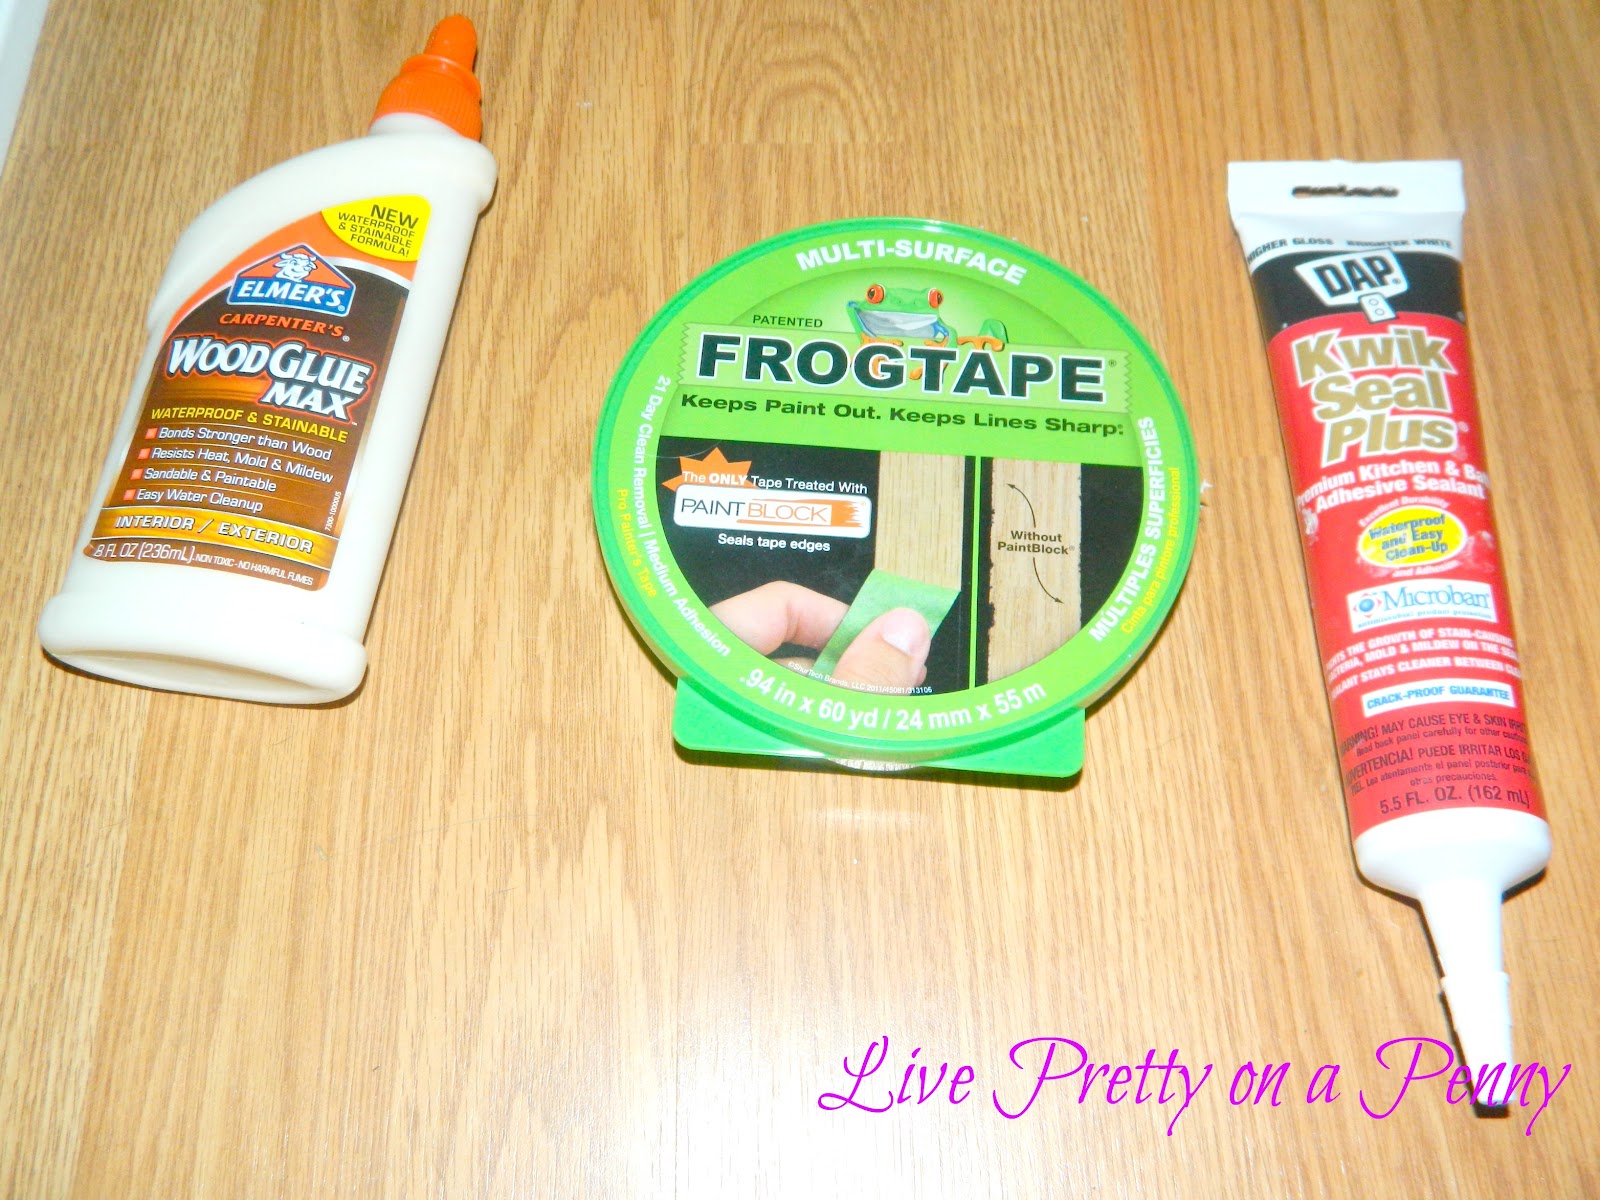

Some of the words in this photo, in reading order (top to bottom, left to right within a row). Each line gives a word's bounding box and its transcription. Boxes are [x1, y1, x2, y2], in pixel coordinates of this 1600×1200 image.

[338, 211, 415, 238] WATERPROOF
[371, 205, 418, 229] NEW
[339, 222, 346, 231] &
[349, 224, 412, 249] STAINABLE
[350, 233, 410, 257] FORMULA!
[796, 239, 1027, 286] MULTI-SURFACE
[1314, 255, 1394, 297] DAP
[237, 280, 345, 308] ELMER'S
[219, 312, 345, 338] CARPENTER'S
[752, 315, 823, 328] PATENTED
[697, 332, 1106, 403] FROGTAPE
[1292, 325, 1458, 387] Kwik
[658, 376, 670, 393] 21
[1311, 369, 1452, 421] Seal
[259, 379, 355, 420] MAX
[642, 394, 663, 420] Day
[682, 394, 757, 413] Keeps
[765, 398, 825, 417] Paint
[834, 403, 882, 420] Out.
[890, 408, 966, 427] Keeps
[974, 412, 1038, 430] Lines
[151, 407, 244, 421] WATERPROOF
[247, 412, 257, 423] &
[263, 414, 349, 443] STAINABLE
[158, 428, 196, 439] Bonds
[197, 429, 255, 445] Stronger
[257, 436, 288, 450] than
[292, 441, 332, 460] Wood
[634, 422, 653, 464] Clean
[1321, 411, 1458, 468] Plus
[151, 447, 195, 460] Resists
[198, 449, 231, 463] Heat,
[234, 453, 269, 469] Mold
[271, 460, 282, 471] &
[285, 462, 334, 483] Mildew
[1138, 416, 1165, 540] SUPERFICIES
[1359, 459, 1441, 481] Kitchen
[1445, 460, 1460, 476] &
[144, 468, 198, 480] Sandable
[201, 470, 212, 481] &
[215, 472, 277, 492] Paintable
[682, 472, 706, 483] The
[708, 473, 747, 486] ONLY
[751, 476, 782, 488] Tape
[785, 478, 834, 491] Treated
[838, 482, 867, 494] With
[136, 489, 165, 502] Easy
[167, 490, 207, 502] Water
[210, 491, 263, 513] Cleanup
[616, 488, 628, 510] Pro
[633, 468, 652, 531] Removal
[1316, 478, 1408, 514] Adhesive
[1412, 475, 1486, 499] Sealant
[116, 516, 195, 530] INTERIOR
[218, 522, 314, 554] EXTERIOR
[620, 513, 642, 567] Painter's
[1011, 531, 1062, 542] Without
[1369, 514, 1445, 540] Waterproof
[1412, 529, 1443, 541] Easy
[718, 533, 753, 546] Seals
[757, 537, 786, 550] tape
[790, 540, 831, 552] edges
[997, 542, 1069, 555] PaintBlock
[1386, 540, 1448, 561] Clean-Up
[94, 544, 104, 557] 8
[105, 544, 117, 557] FL
[120, 543, 139, 557] OZ
[214, 555, 234, 566] TOXIC
[238, 560, 250, 569] NO
[251, 563, 286, 578] HARMFUL
[288, 572, 313, 585] FUMES
[643, 539, 678, 597] Medium
[638, 568, 656, 598] Tape
[1143, 581, 1161, 606] para
[1382, 585, 1489, 611] Microban
[673, 598, 730, 657] Adhesion
[1347, 641, 1366, 656] THE
[1368, 630, 1417, 649] GROWTH
[1420, 629, 1435, 639] OF
[1364, 646, 1397, 662] MOLD
[1400, 644, 1410, 653] &
[1413, 640, 1459, 650] MILDEW
[1361, 664, 1395, 682] STAYS
[1398, 657, 1452, 672] CLEANER
[773, 682, 796, 706] in
[799, 697, 814, 714] x
[818, 700, 845, 722] 60
[848, 708, 879, 731] yd
[895, 709, 922, 730] 24
[928, 706, 971, 729] mm
[977, 704, 992, 721] x
[993, 688, 1022, 715] 55
[1023, 682, 1046, 702] m
[1366, 686, 1445, 709] CRACK-PROOF
[1450, 685, 1511, 701] GUARANTEE
[1375, 737, 1393, 748] back
[1397, 732, 1420, 745] panel
[1423, 728, 1461, 738] carefully
[1480, 728, 1501, 737] other
[1381, 720, 1404, 735] MAY
[1409, 715, 1445, 729] CAUSE
[1449, 714, 1469, 725] EYE
[1473, 715, 1481, 724] &
[1484, 714, 1507, 727] SKIN
[1419, 747, 1455, 758] PUEDE
[1460, 746, 1501, 756] IRRITAR
[1505, 747, 1521, 761] LOS
[1436, 762, 1444, 770] el
[1448, 759, 1472, 769] panel
[1475, 761, 1510, 770] posterior
[1379, 797, 1401, 815] 5.5
[1406, 792, 1429, 806] FL.
[1434, 786, 1462, 801] OZ.
[1468, 785, 1503, 803] (162
[1507, 791, 1530, 809] mL)
